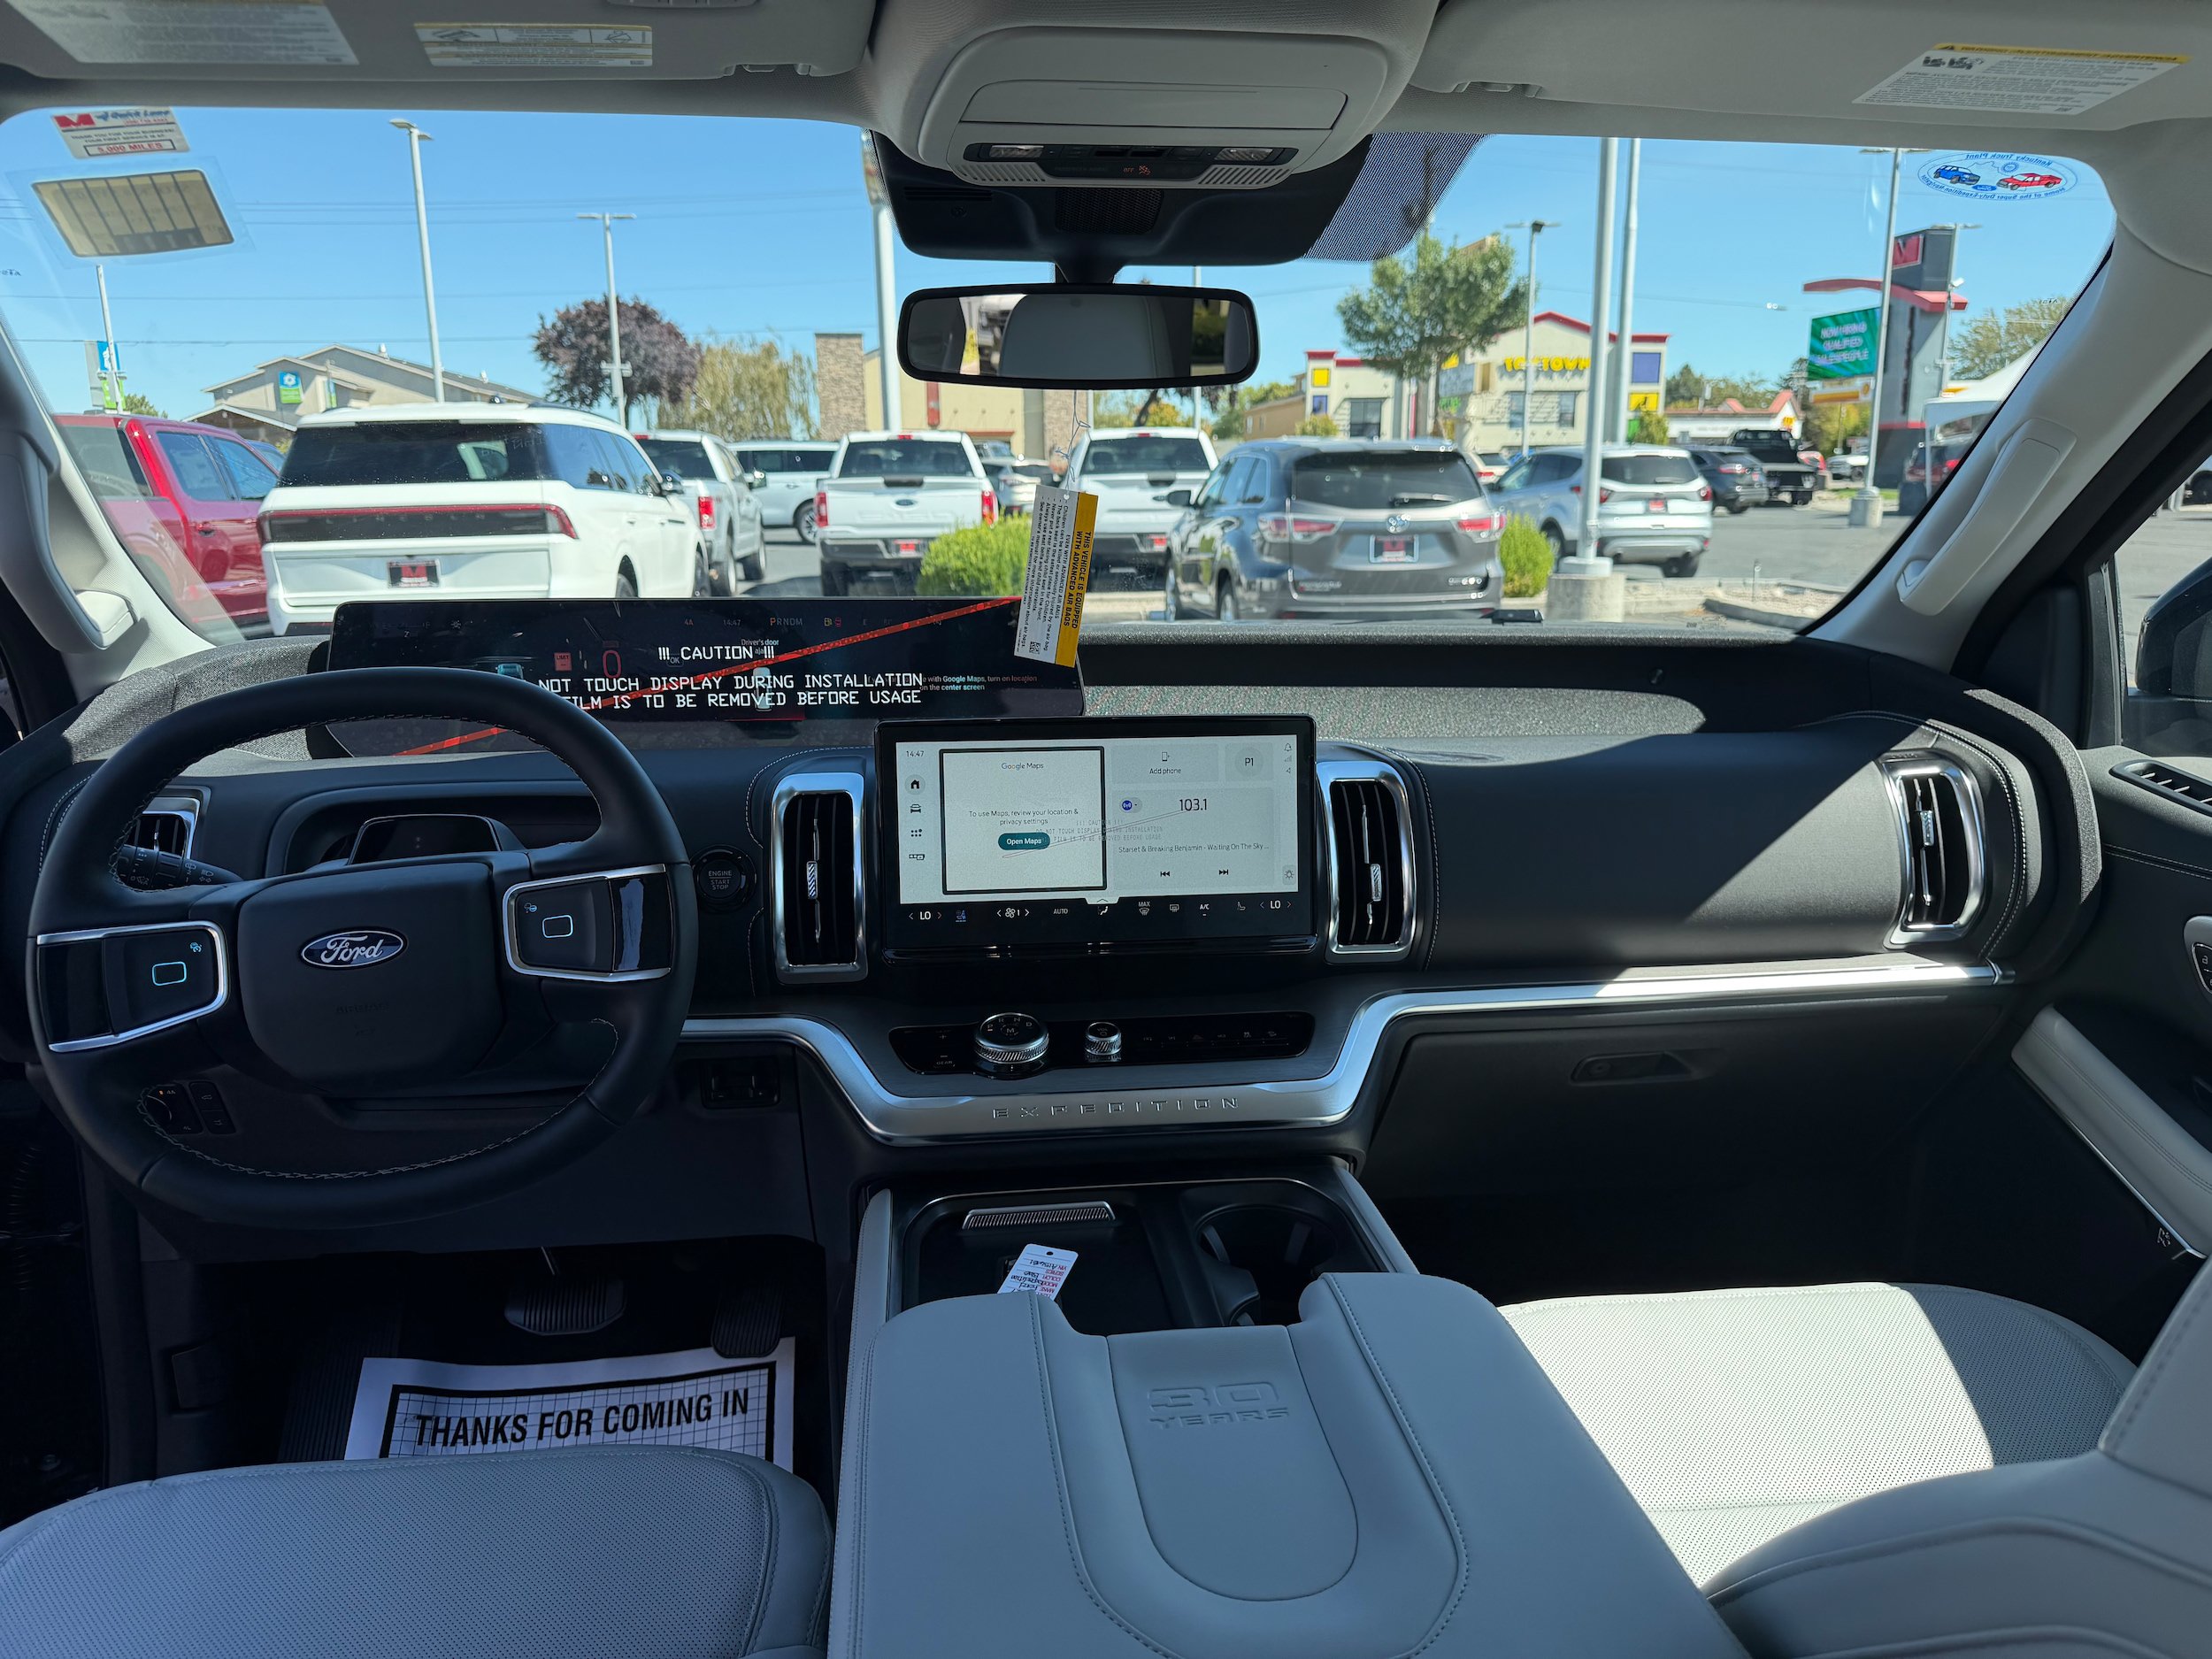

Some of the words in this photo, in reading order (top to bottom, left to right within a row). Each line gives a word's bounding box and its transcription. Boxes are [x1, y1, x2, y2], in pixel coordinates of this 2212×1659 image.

[111, 110, 140, 119] Quick
[97, 144, 125, 153] 5,000
[128, 142, 162, 150] MILES
[1082, 531, 1091, 548] THIS
[1069, 551, 1079, 590] ADVANCED
[1078, 550, 1088, 581] VEHICLE
[1071, 592, 1082, 628] EQUIPPED
[680, 646, 752, 660] CAUTION
[603, 650, 621, 678] 0
[539, 679, 571, 694] NOT
[584, 678, 639, 692] TOUCH
[650, 677, 722, 690] DISPLAY
[734, 675, 794, 689] DURING
[805, 673, 923, 688] INSTALLATION
[613, 695, 631, 708] IS
[643, 695, 664, 707] TO
[676, 695, 696, 707] BE
[708, 693, 786, 707] REMOVED
[797, 691, 859, 704] BEFORE
[871, 690, 922, 703] USAGE
[1245, 757, 1254, 766] P1
[1179, 799, 1208, 811] 103.1
[1148, 845, 1173, 854] Breaking
[1270, 900, 1281, 909] LO
[920, 911, 931, 920] LO
[320, 935, 384, 964] Ford
[992, 1097, 1239, 1120] EXPEDITION
[415, 1413, 527, 1447] THANKS
[537, 1408, 593, 1440] FOR
[603, 1393, 712, 1433] COMING
[722, 1387, 749, 1417] IN
[1149, 1407, 1289, 1430] YEARS
